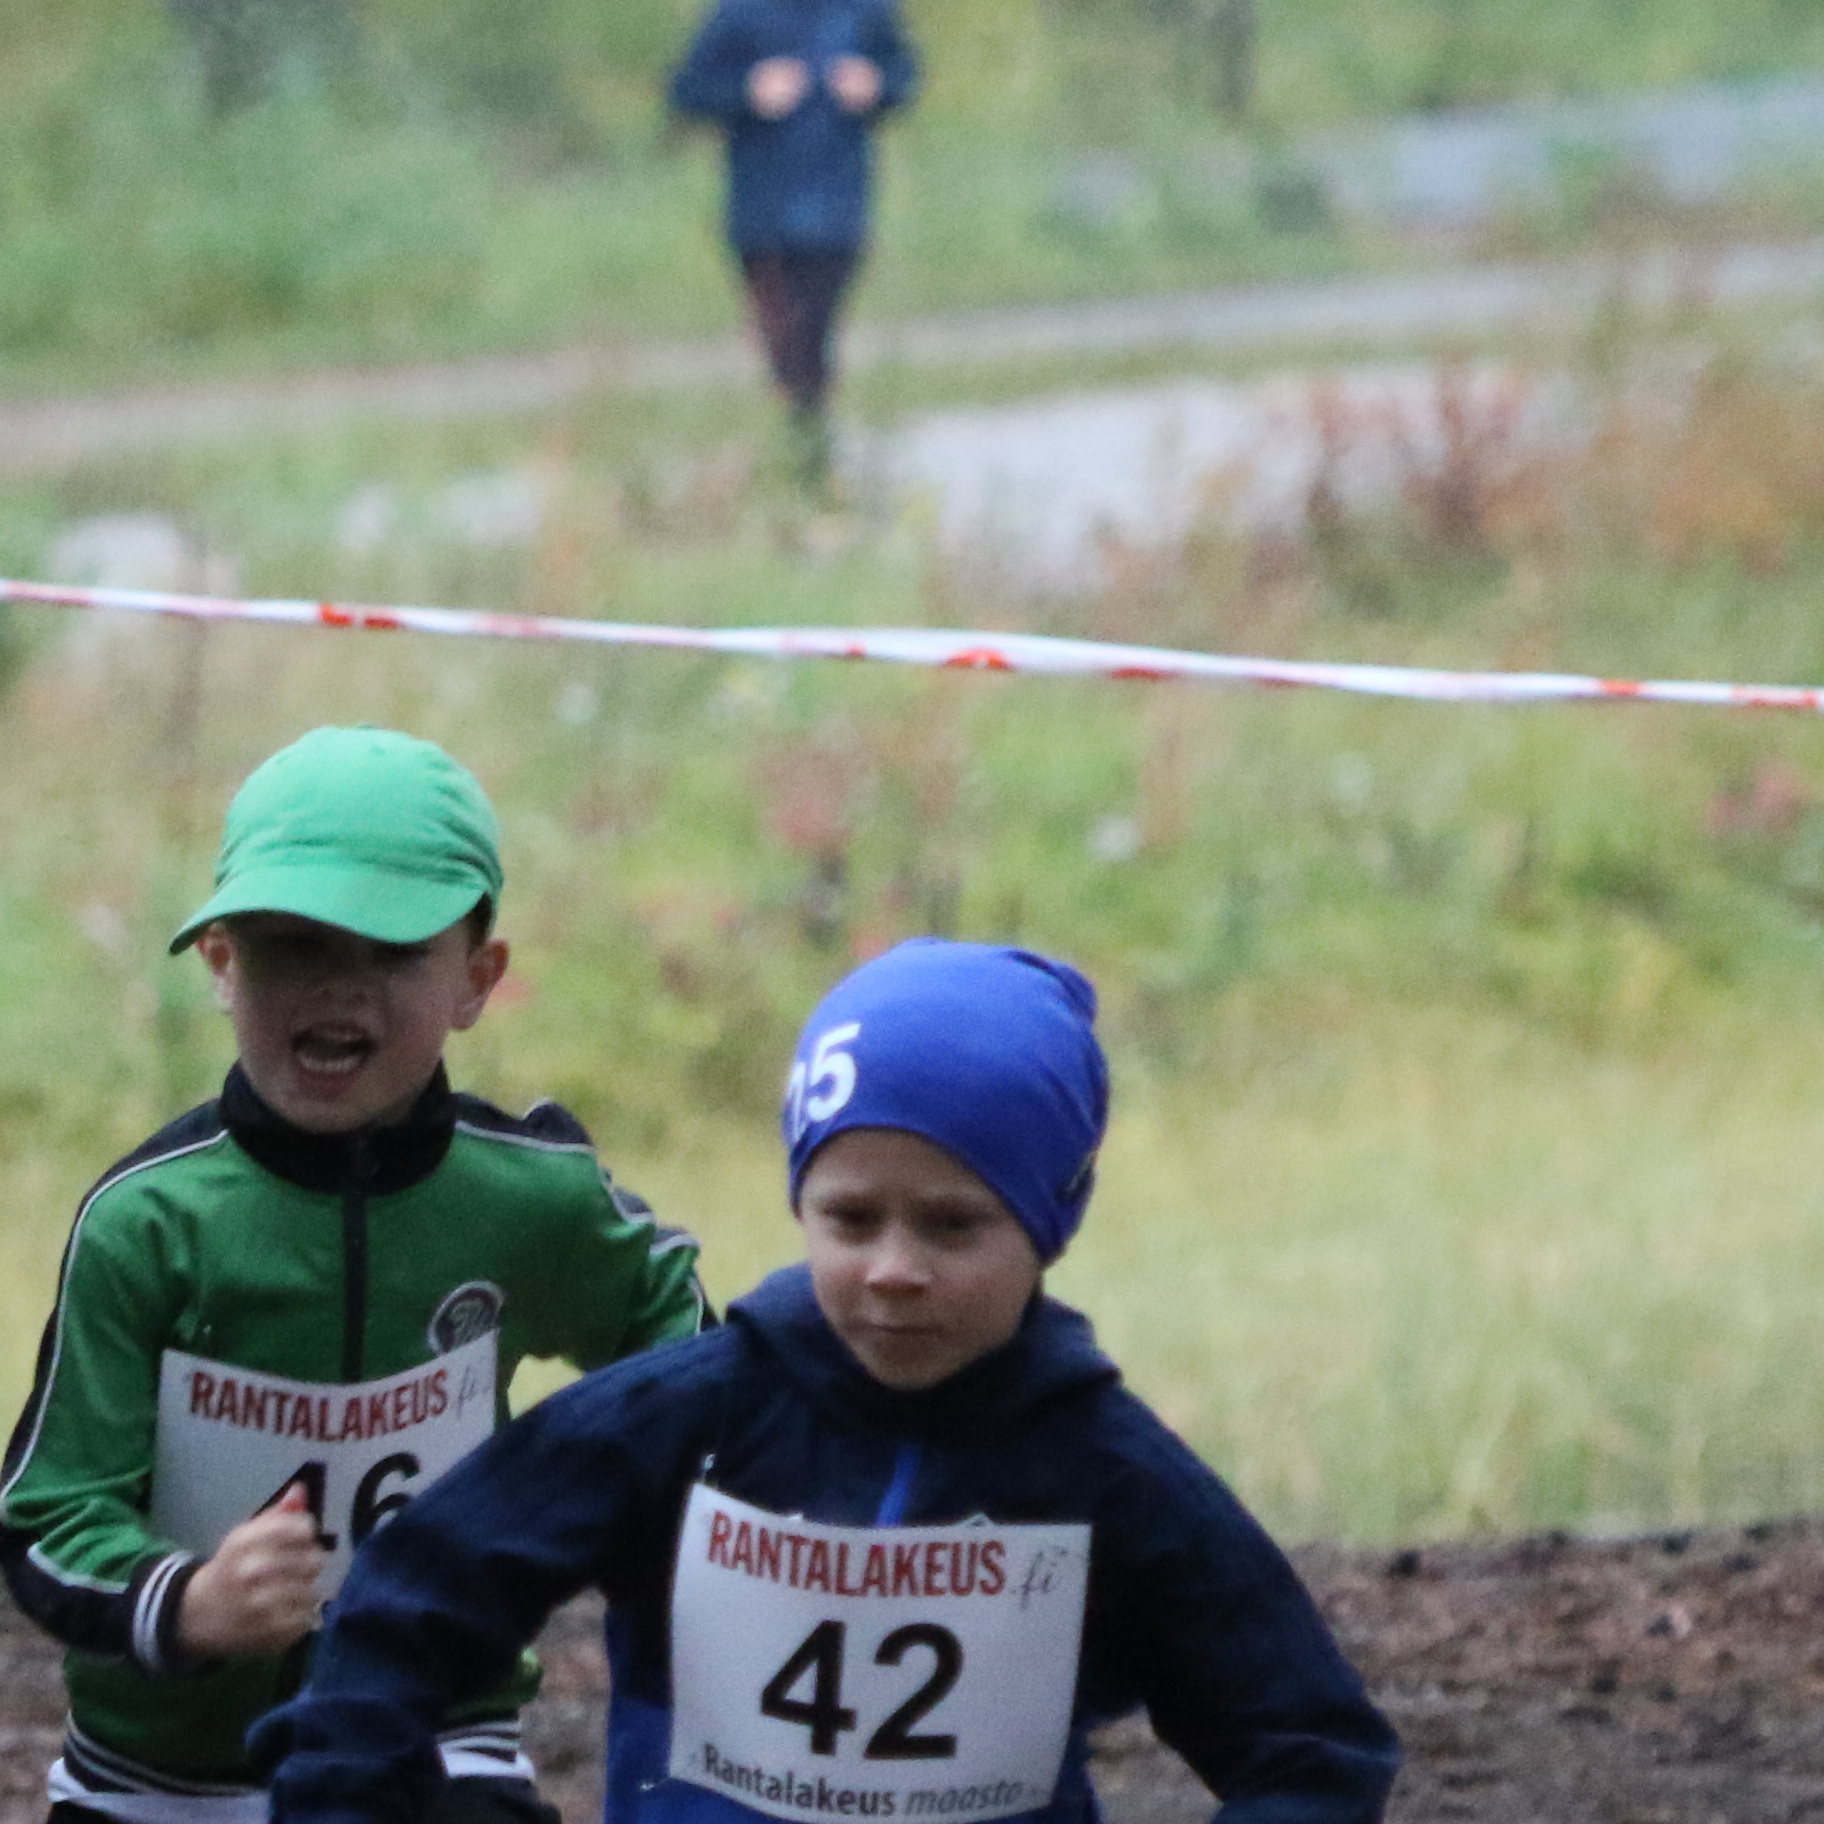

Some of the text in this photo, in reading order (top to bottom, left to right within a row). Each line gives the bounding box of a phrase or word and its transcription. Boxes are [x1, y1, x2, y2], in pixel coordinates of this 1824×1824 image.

[760, 1619, 964, 1760] 42
[702, 1743, 1025, 1816] Rantalakeus maasto
